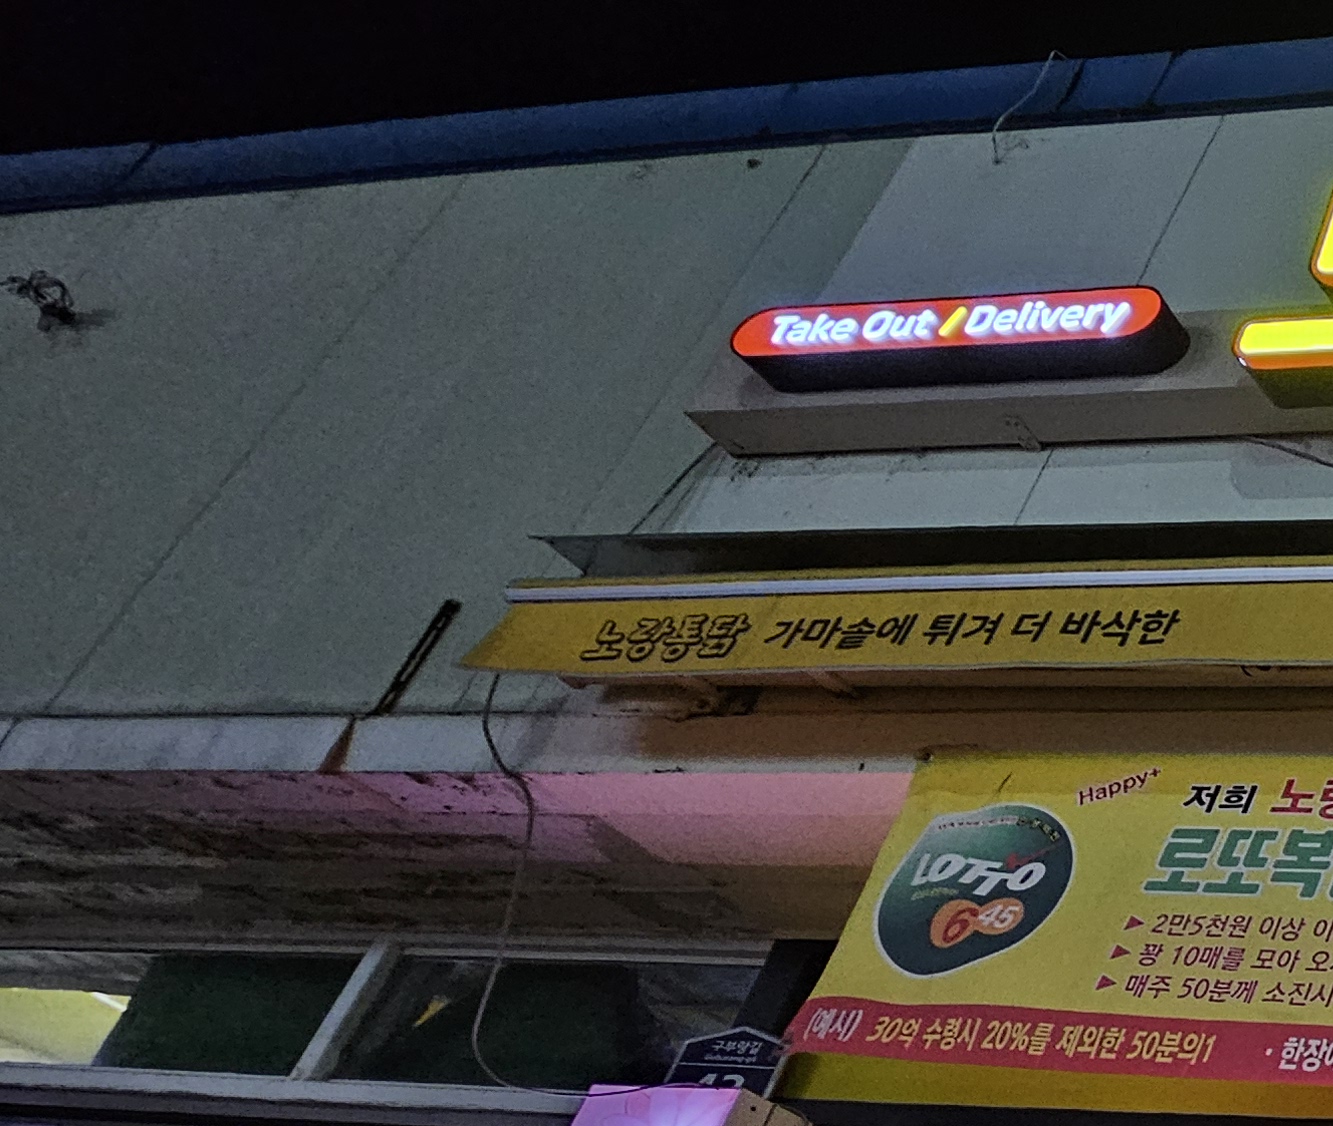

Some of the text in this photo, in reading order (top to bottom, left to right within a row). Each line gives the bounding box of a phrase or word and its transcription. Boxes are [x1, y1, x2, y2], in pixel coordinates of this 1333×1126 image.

[770, 312, 858, 346] Take
[861, 307, 935, 341] Out
[964, 300, 1132, 337] Delivery
[580, 607, 1182, 664] 노랑통닭 가마솥에 튀겨 더 바삭한
[1076, 768, 1163, 807] Happy+
[1182, 783, 1258, 815] 저희
[909, 853, 1047, 897] LOTTO
[1150, 913, 1254, 938] 2만5천원
[1257, 917, 1306, 941] 이상
[1171, 945, 1246, 971] 10매를
[1253, 947, 1301, 973] 모아
[1123, 973, 1172, 999] 매주
[1182, 975, 1258, 1004] 50분께
[802, 1007, 864, 1043] (예시)
[865, 1015, 923, 1051] 30억
[922, 1017, 983, 1052] 수령시
[980, 1019, 1055, 1056] 20%를
[1055, 1022, 1127, 1062] 제외한
[1126, 1028, 1217, 1066] 50분의1
